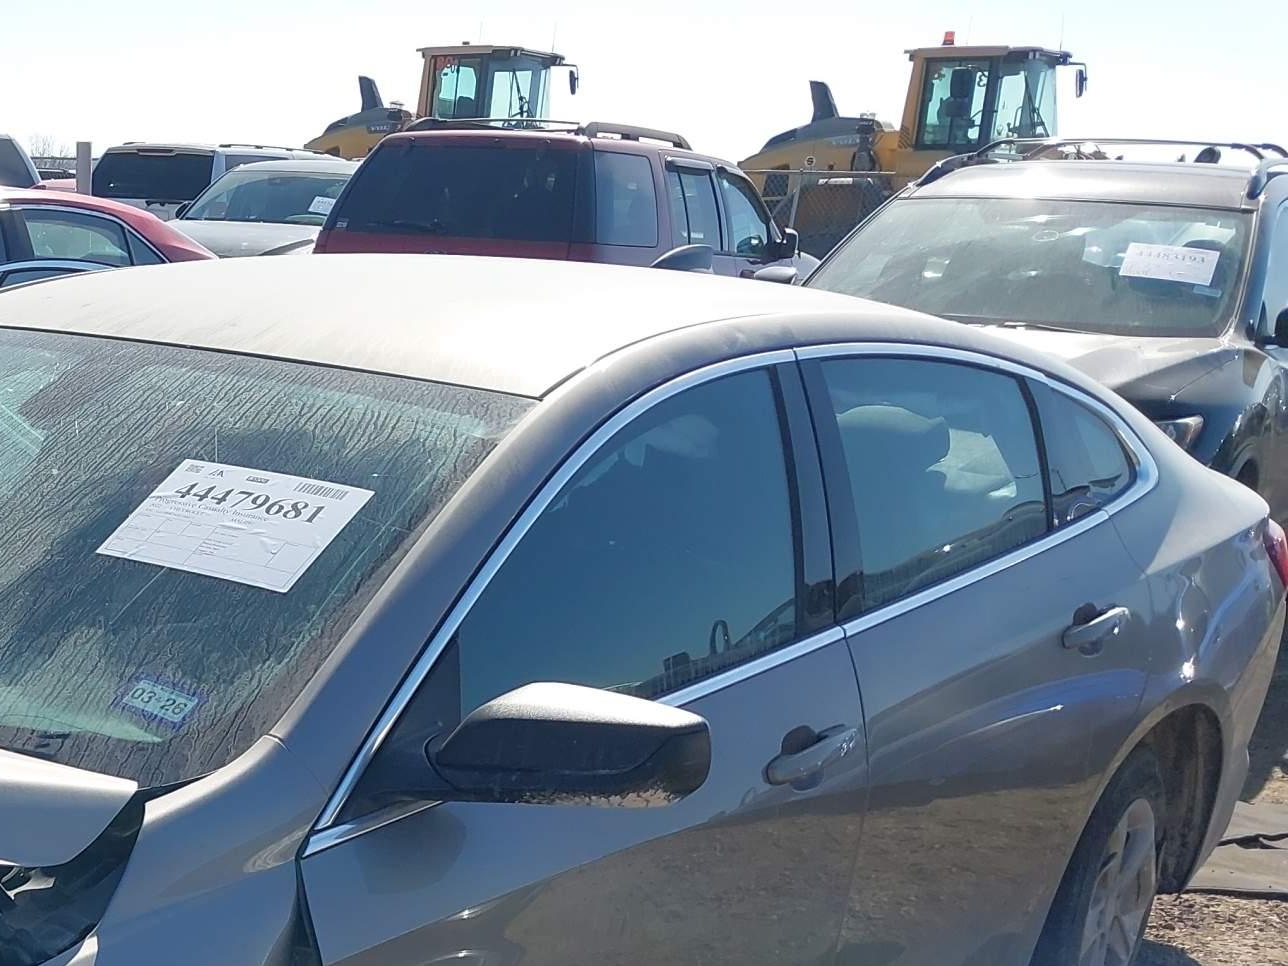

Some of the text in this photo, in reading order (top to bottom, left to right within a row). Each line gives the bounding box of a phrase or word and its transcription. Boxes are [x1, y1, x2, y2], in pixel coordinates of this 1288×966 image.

[175, 482, 326, 524] 44479681
[197, 504, 231, 515] Casualty
[231, 509, 270, 521] Insurance
